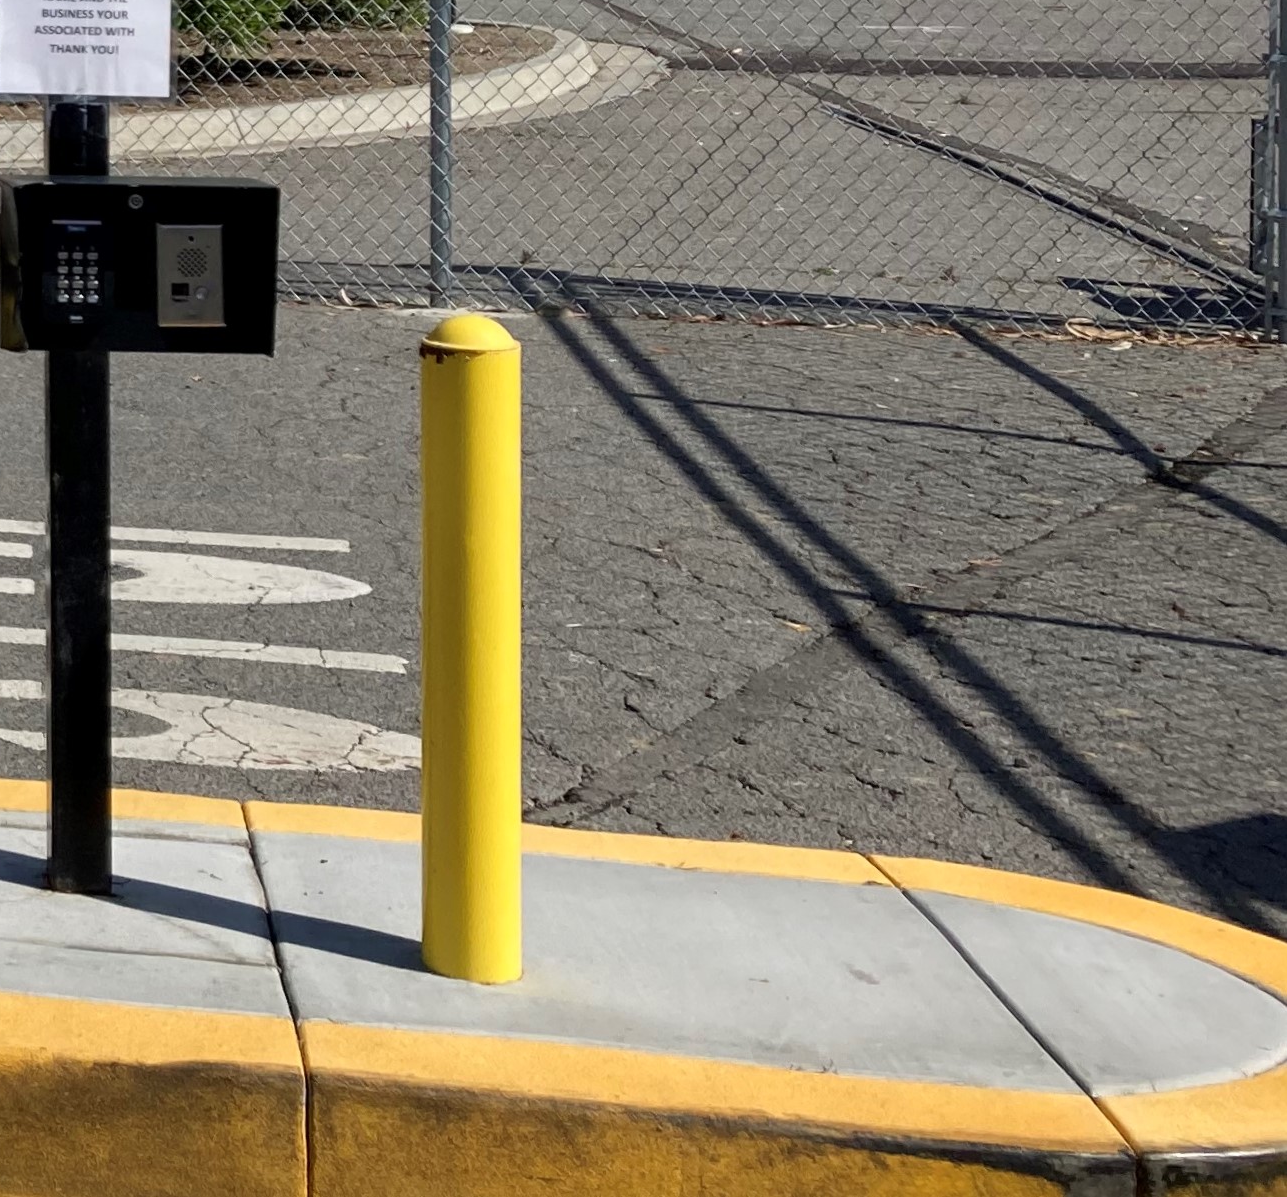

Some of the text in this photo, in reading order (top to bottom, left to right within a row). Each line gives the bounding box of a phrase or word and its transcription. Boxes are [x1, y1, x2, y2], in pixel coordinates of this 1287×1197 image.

[41, 9, 129, 20] BUSINESS YOUR
[34, 25, 135, 36] ASSOCIATED WITH
[50, 44, 120, 55] THANK YOU!
